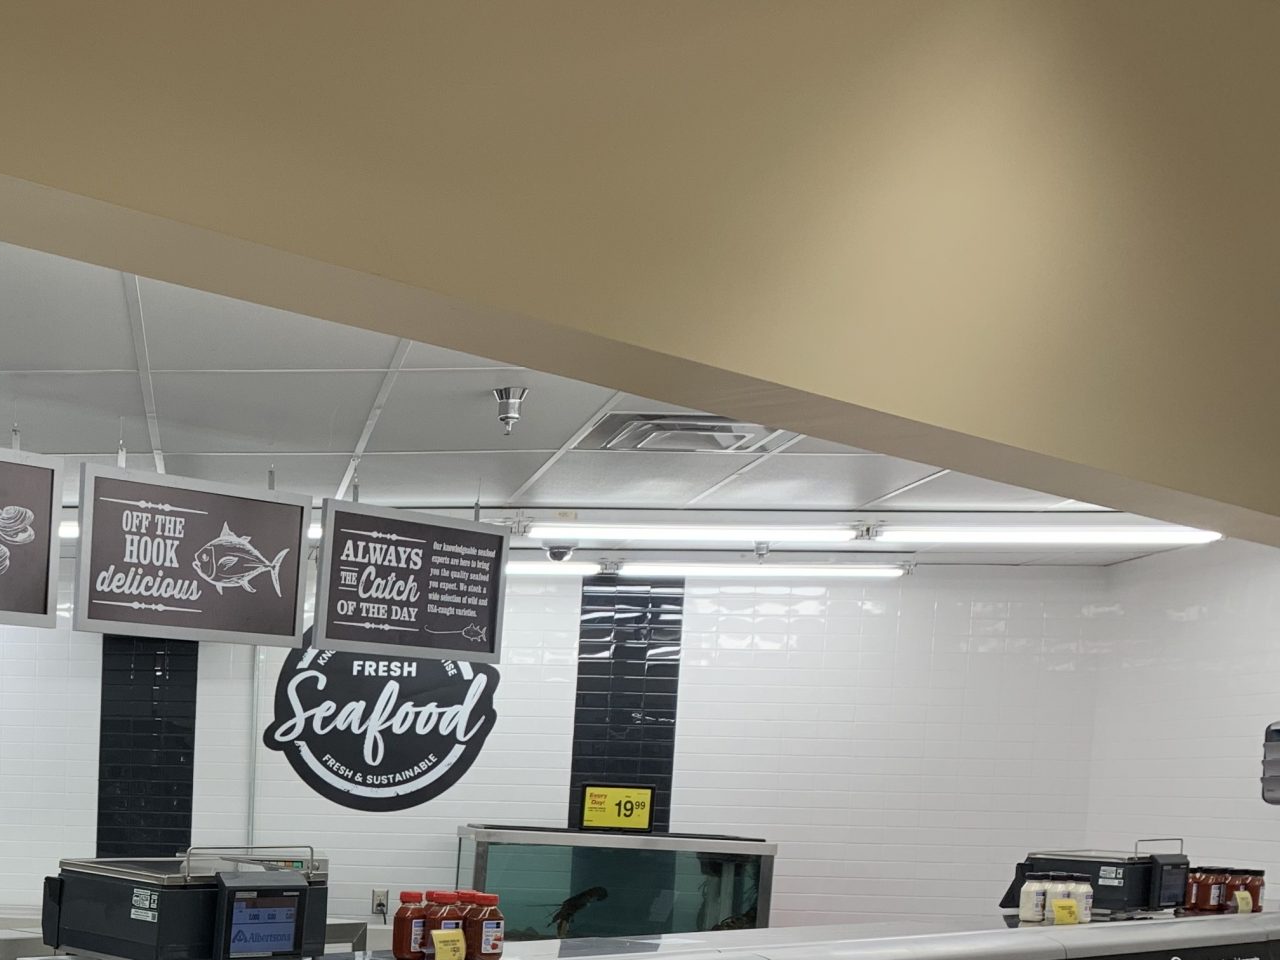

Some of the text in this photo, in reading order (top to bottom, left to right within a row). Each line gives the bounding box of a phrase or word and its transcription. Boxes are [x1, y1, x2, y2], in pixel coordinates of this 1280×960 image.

[122, 510, 185, 538] OFF THE
[123, 534, 179, 568] HOOK
[340, 540, 423, 570] ALWAYS
[96, 565, 202, 601] delicious
[340, 566, 420, 603] THE Catch
[450, 570, 469, 581] quality
[336, 600, 418, 622] OF THE DAY
[352, 660, 417, 677] FRESH
[274, 670, 488, 767] Seafood
[322, 753, 438, 785] FRESH & SUSTAINABLE
